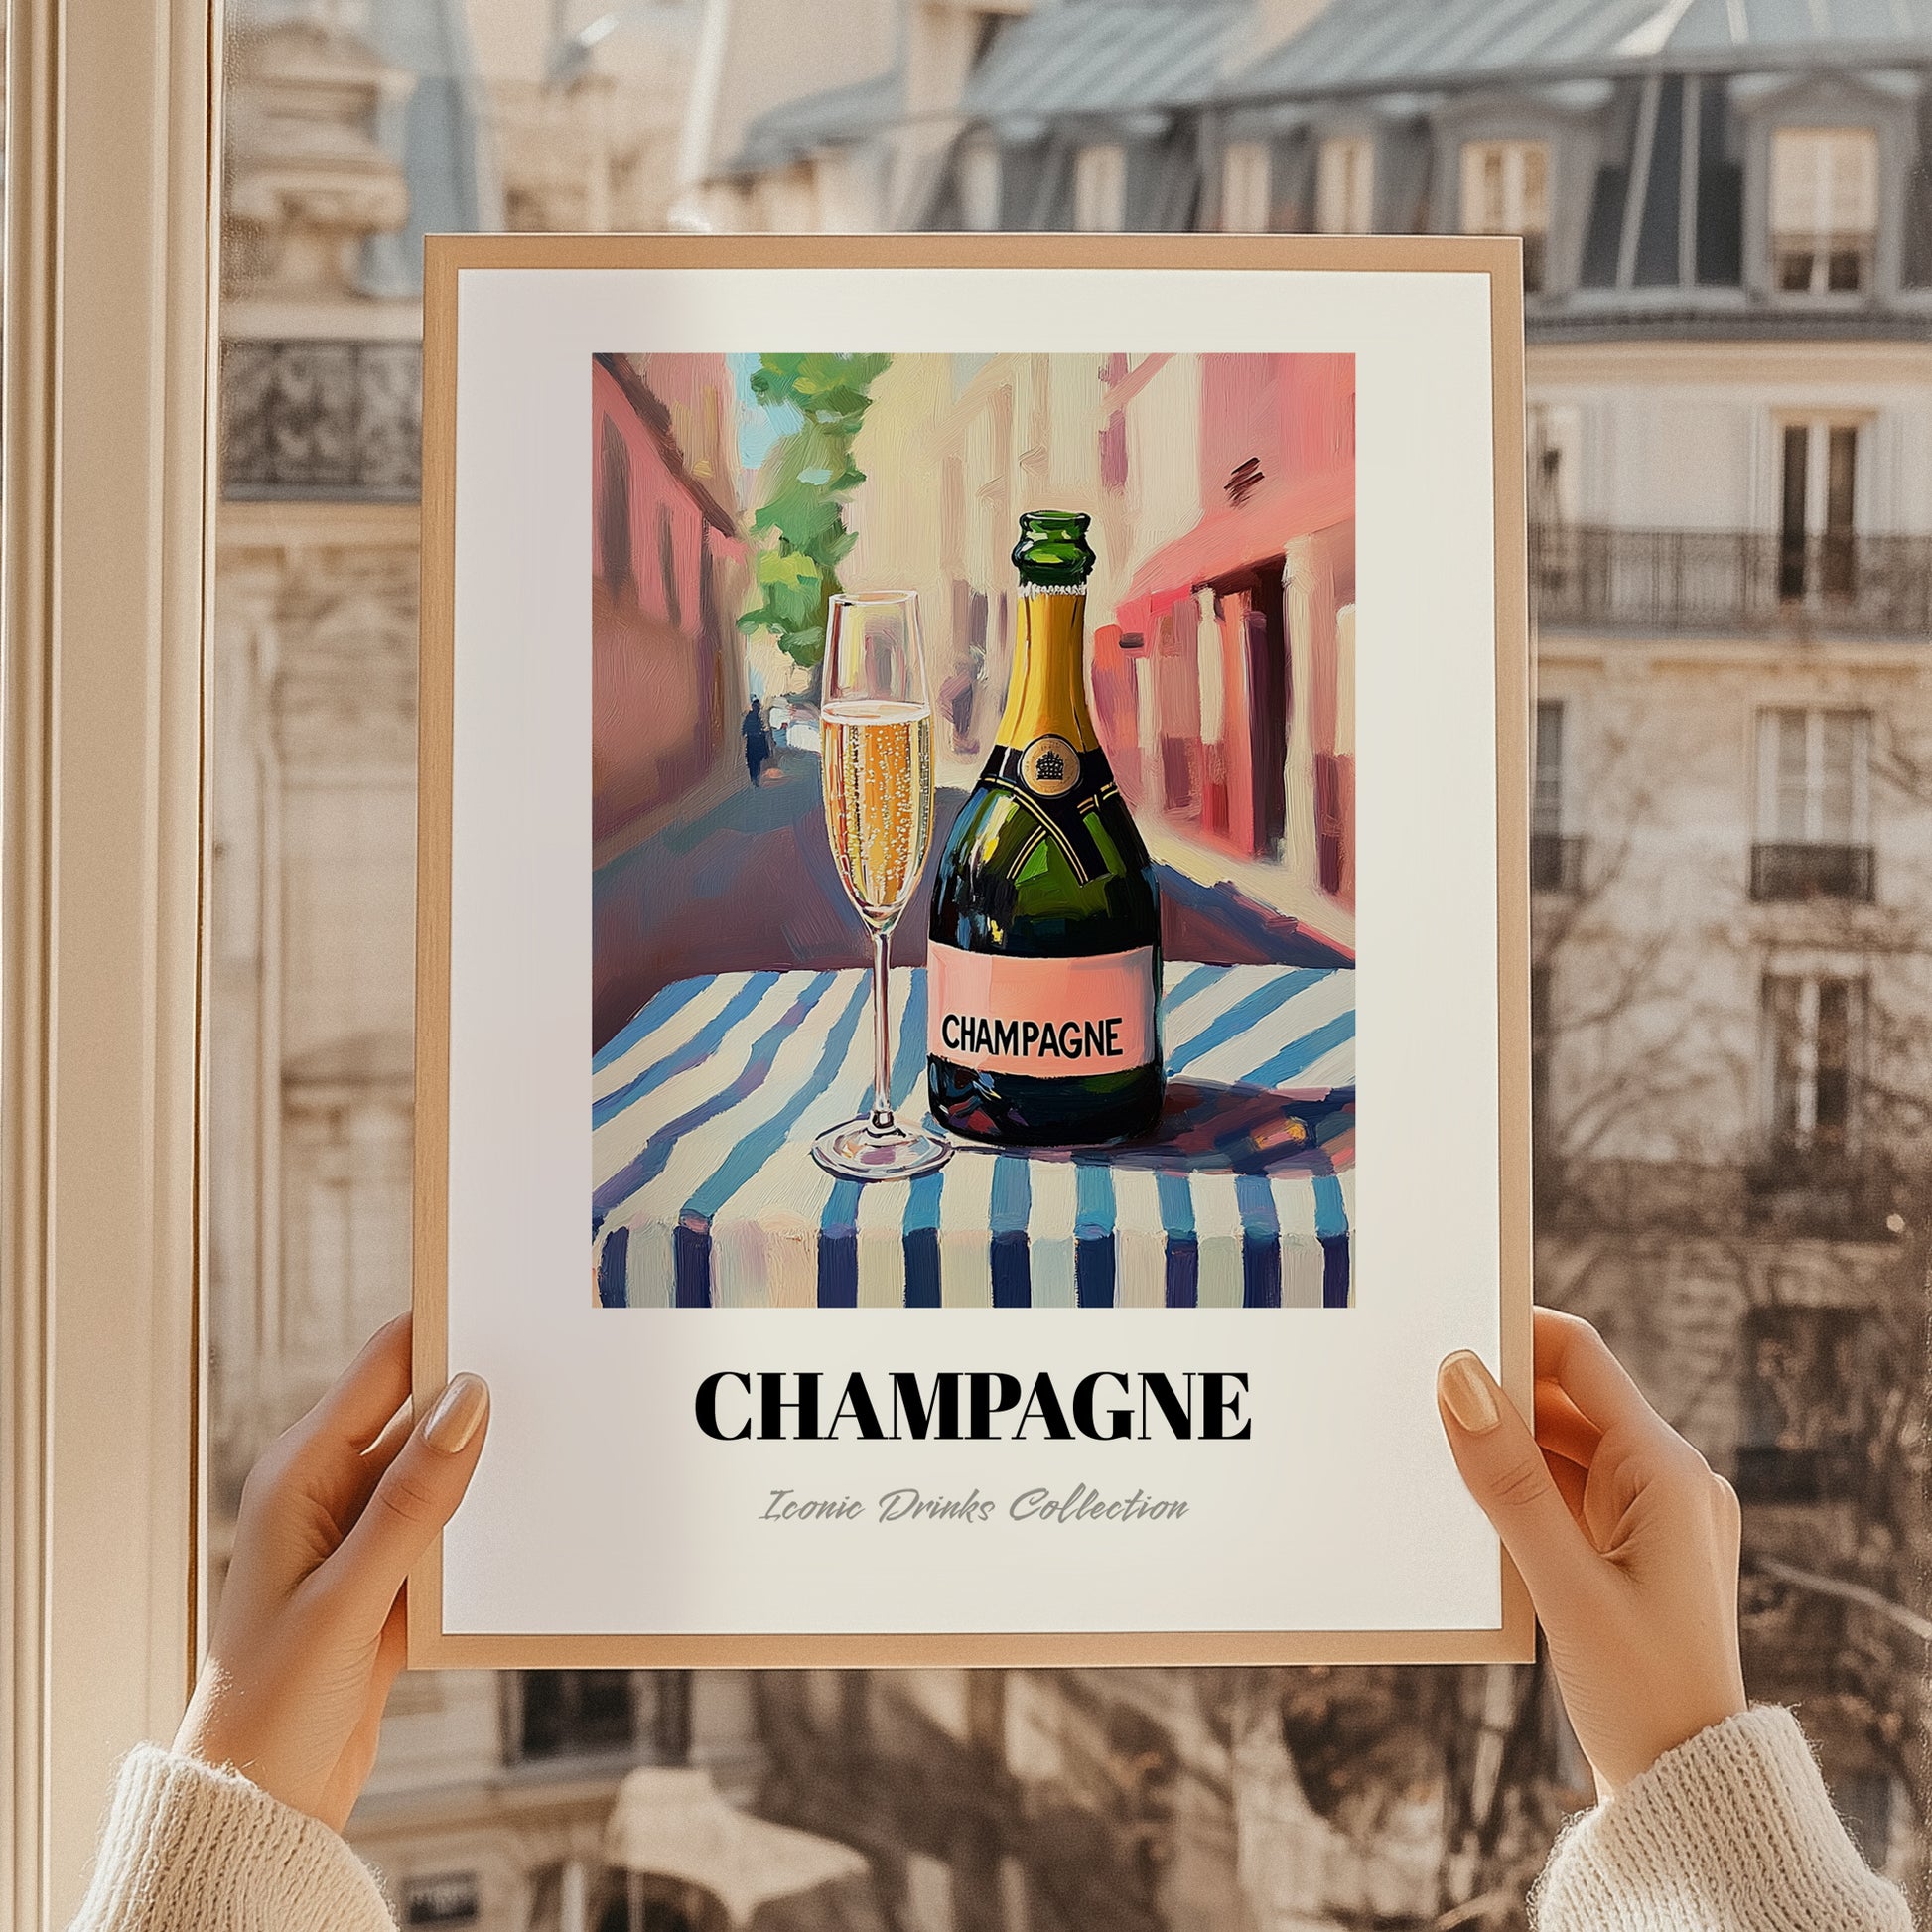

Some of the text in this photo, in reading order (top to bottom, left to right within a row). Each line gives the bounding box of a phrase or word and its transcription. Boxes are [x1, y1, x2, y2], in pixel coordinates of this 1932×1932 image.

[942, 1014, 1124, 1059] CHAMPAGNE
[695, 1371, 1252, 1441] CHAMPAGNE
[758, 1482, 1190, 1524] Iconic Drinks Collection
